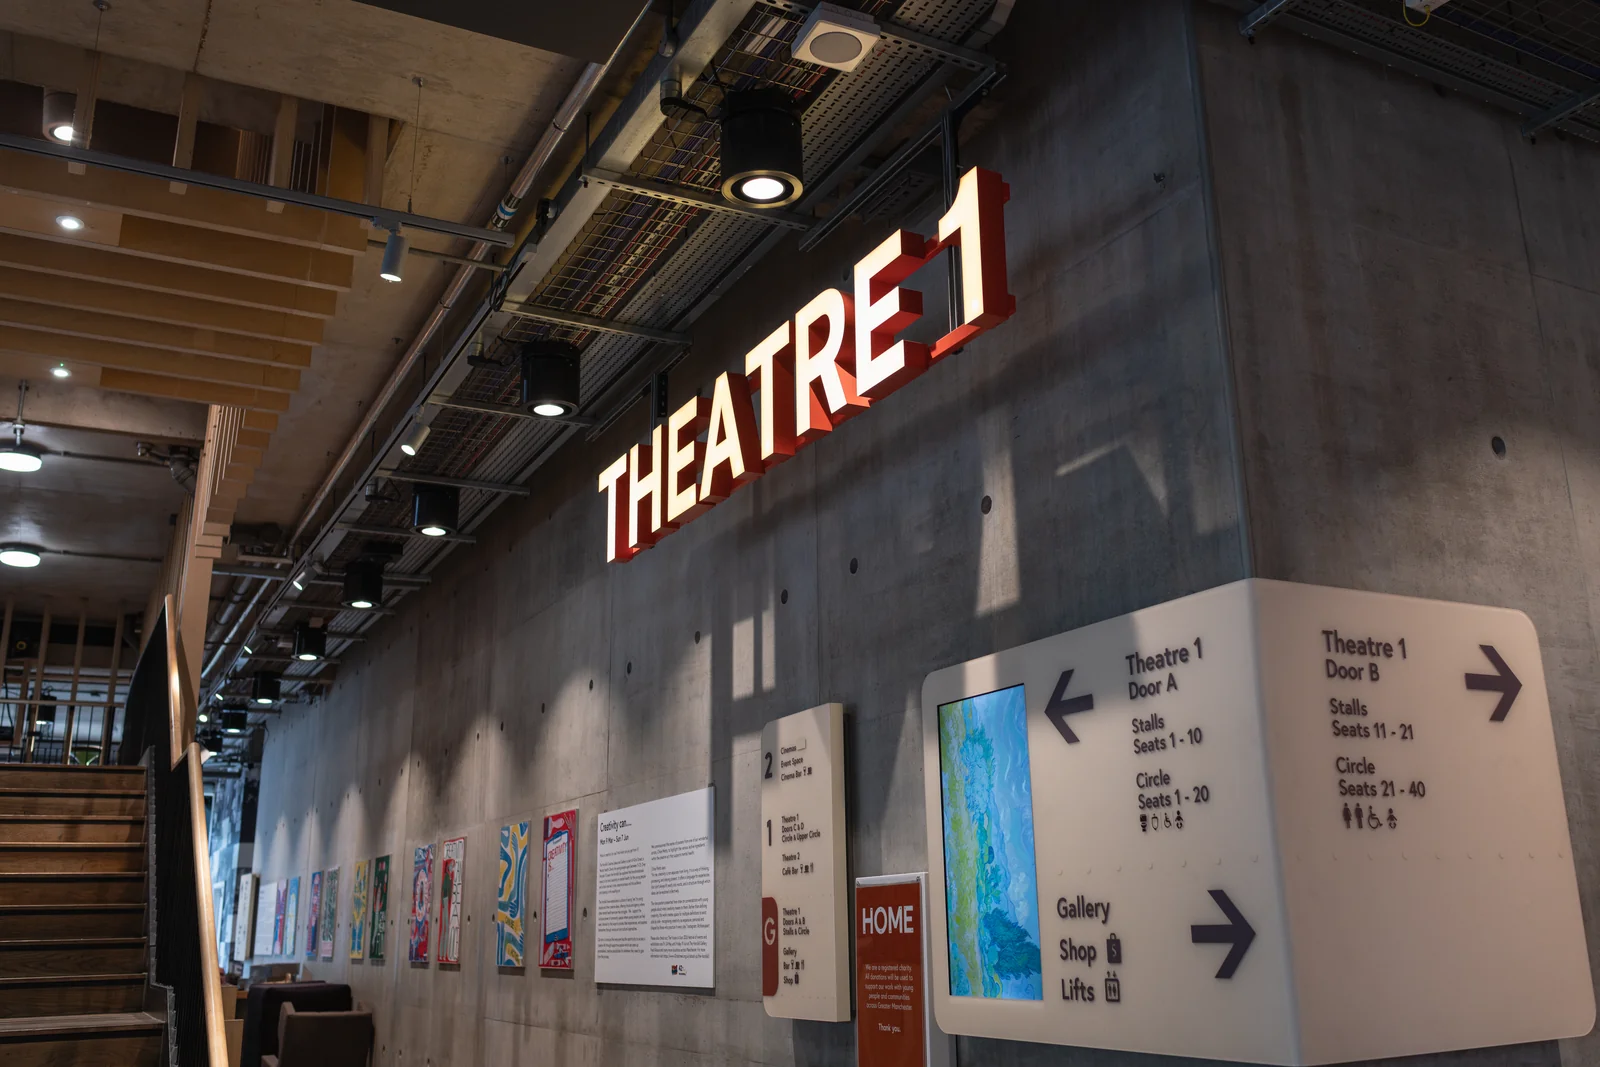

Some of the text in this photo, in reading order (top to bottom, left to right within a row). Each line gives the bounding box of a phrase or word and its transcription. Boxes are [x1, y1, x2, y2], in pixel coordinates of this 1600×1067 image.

[598, 166, 984, 562] THEATRE 1
[1322, 630, 1406, 659] Theatre 1
[1125, 637, 1202, 675] Theatre 1
[1325, 659, 1380, 681] Door B
[1128, 673, 1178, 700] Door A
[1330, 698, 1368, 716] Stalls
[1132, 713, 1164, 734] Stalls
[1332, 720, 1370, 738] Seats
[1374, 723, 1386, 739] 11
[1400, 724, 1414, 740] 21
[781, 745, 796, 755] Cinemas
[1134, 736, 1167, 754] Seats
[1169, 732, 1175, 748] 1
[1187, 727, 1202, 744] 10
[765, 752, 772, 779] 2
[781, 756, 803, 768] Event Space
[1336, 757, 1376, 774] Circle
[781, 771, 795, 781] Cinema
[1136, 769, 1170, 789] Circle
[1138, 792, 1171, 810] Seats
[1174, 789, 1181, 805] 1
[1193, 785, 1209, 803] 20
[1339, 779, 1377, 796] Seats
[1381, 780, 1395, 797] 21
[1409, 781, 1426, 797] 40
[600, 820, 618, 832] Creativity
[782, 815, 796, 823] Theatre
[782, 824, 793, 833] Doors
[793, 824, 797, 832] C
[801, 822, 804, 830] D
[767, 819, 772, 846] 1
[782, 834, 793, 843] Circle
[797, 832, 808, 842] Upper
[809, 830, 821, 839] Circle
[782, 853, 796, 862] Theatre
[783, 908, 797, 916] Theatre
[1057, 895, 1110, 924] Gallery
[783, 918, 794, 926] Doors
[862, 905, 914, 934] HOME
[764, 917, 776, 945] G
[783, 927, 794, 936] Stalls
[798, 927, 810, 935] Circle
[783, 947, 797, 957] Gallery
[1060, 938, 1097, 967] Shop
[784, 976, 793, 986] Shop
[1062, 978, 1094, 1001] Lifts
[878, 1023, 891, 1031] Thank
